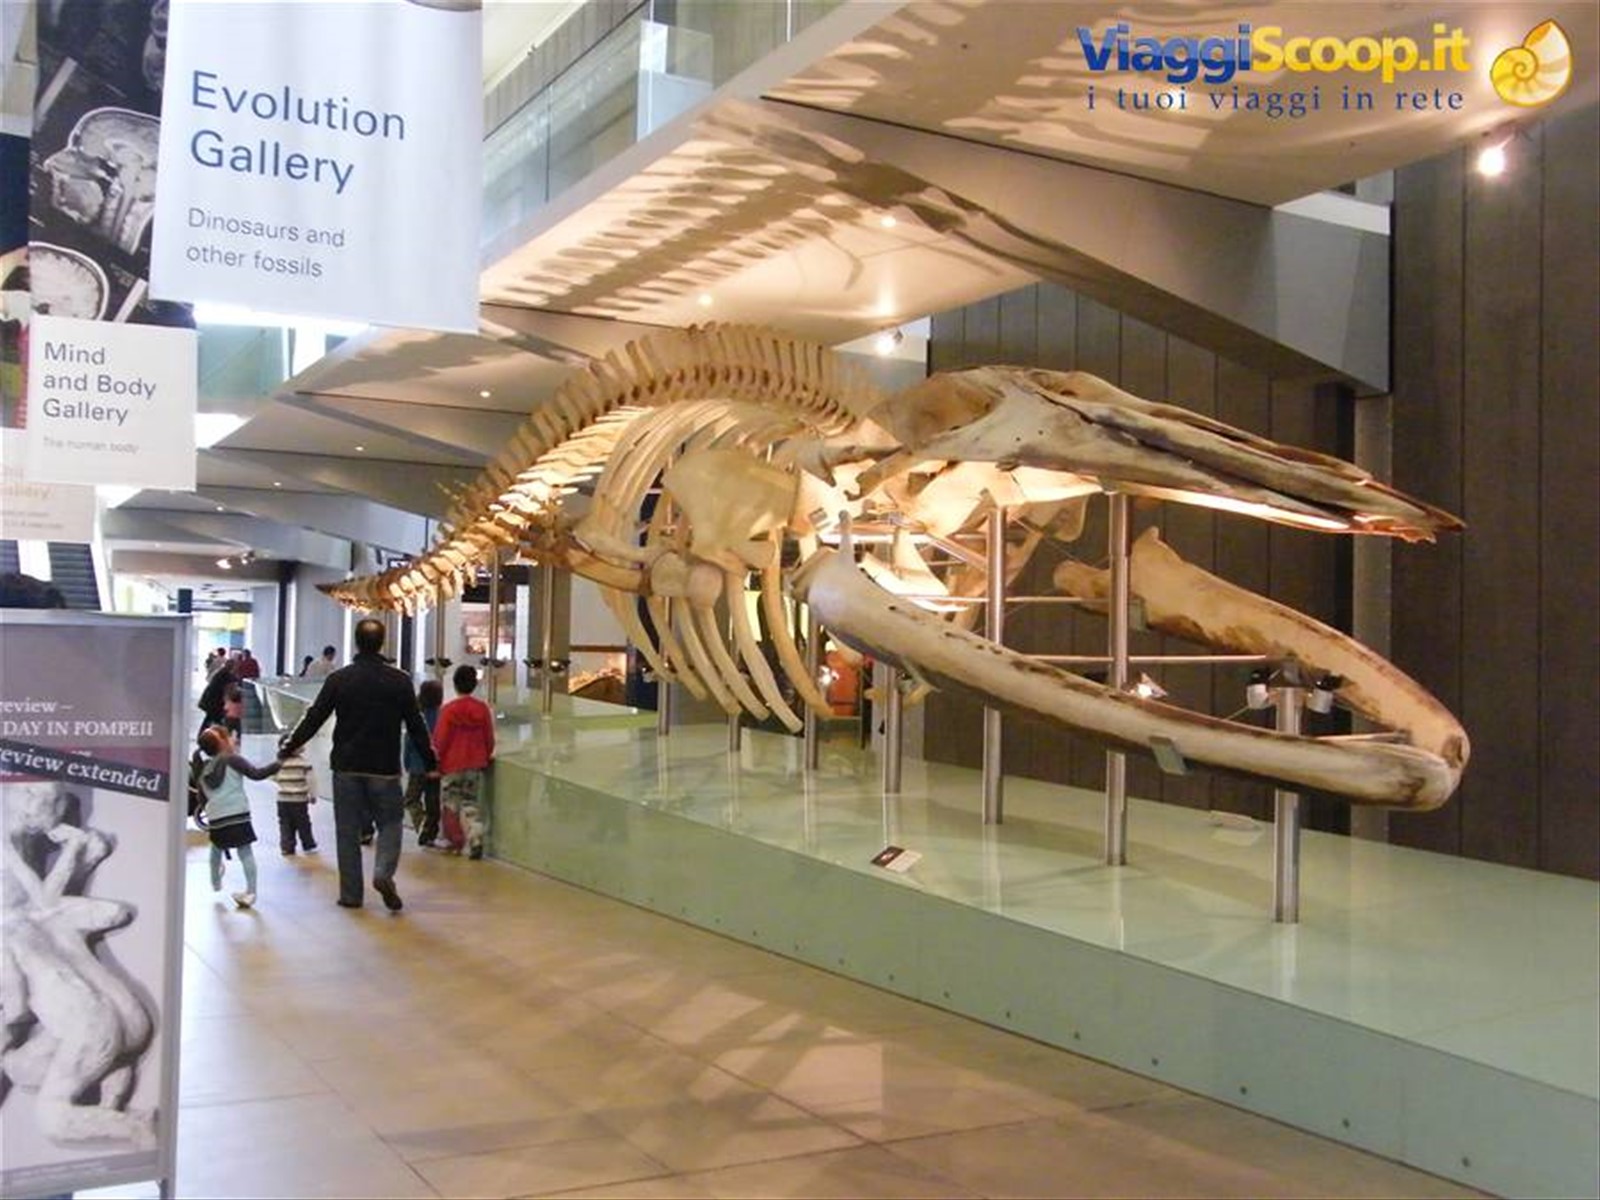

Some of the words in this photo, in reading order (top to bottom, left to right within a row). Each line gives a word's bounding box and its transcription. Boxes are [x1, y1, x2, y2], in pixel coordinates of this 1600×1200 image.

[191, 70, 406, 141] Evolution
[190, 130, 354, 194] Gallery
[188, 208, 299, 242] Dinosaurs
[306, 226, 345, 248] and
[186, 244, 246, 270] other
[254, 250, 323, 278] fossils
[44, 341, 106, 366] Mind
[43, 374, 88, 392] and
[97, 374, 156, 400] Body
[42, 398, 129, 426] Gallery
[3, 720, 43, 736] DAY
[47, 720, 68, 735] IN
[74, 720, 154, 738] POMPEII
[0, 748, 64, 772] eview
[67, 761, 161, 792] extended
